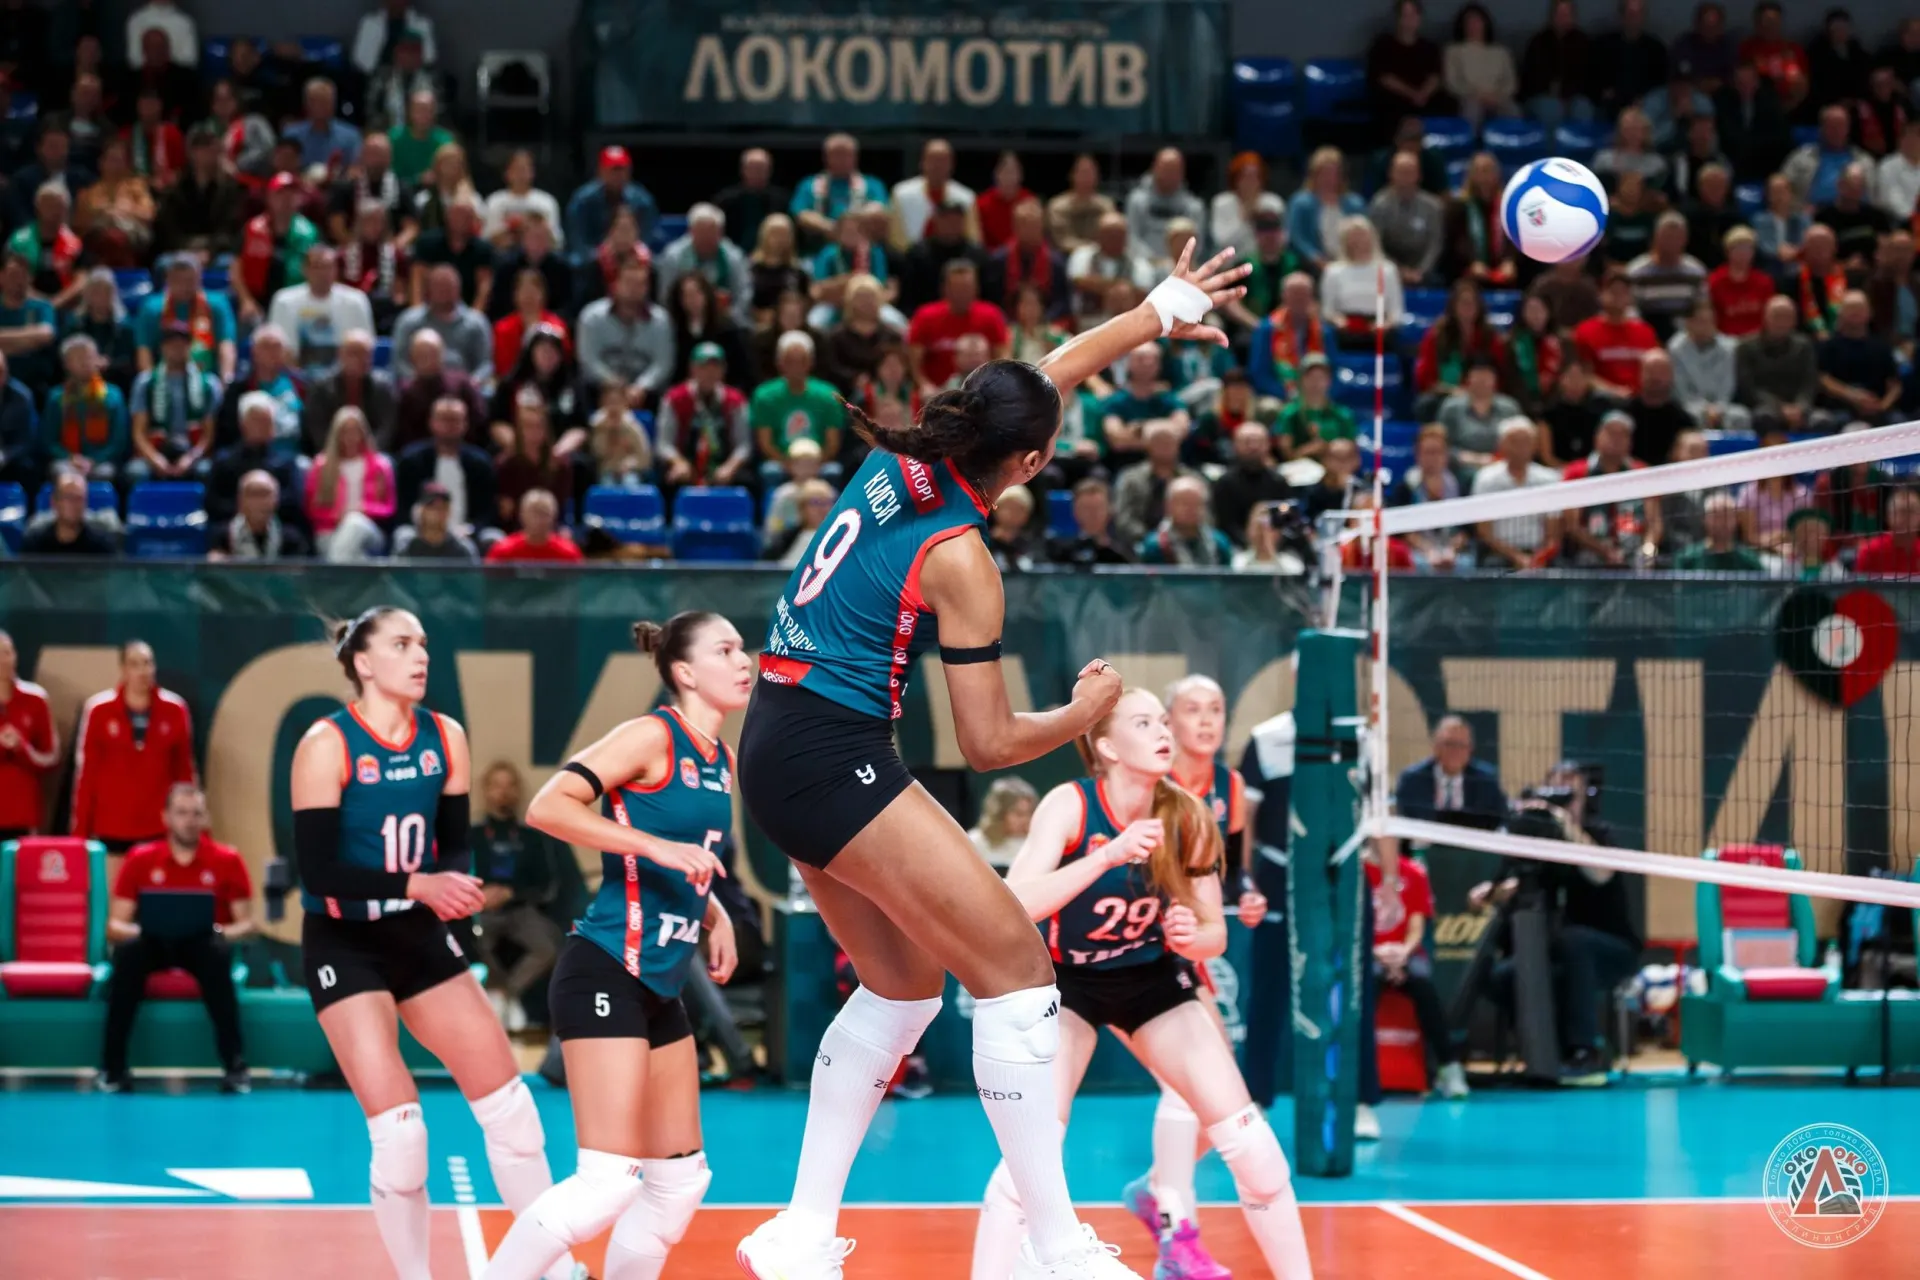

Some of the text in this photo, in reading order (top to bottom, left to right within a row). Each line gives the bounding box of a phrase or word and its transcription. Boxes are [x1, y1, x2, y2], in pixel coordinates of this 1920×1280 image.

[684, 34, 1148, 108] ЛОКОМОТИВ
[864, 468, 901, 526] КИСИ
[793, 508, 861, 607] 9
[855, 763, 876, 785] 9
[381, 813, 426, 873] 10
[1086, 897, 1162, 942] 29
[317, 964, 337, 989] 10
[594, 992, 611, 1017] 5
